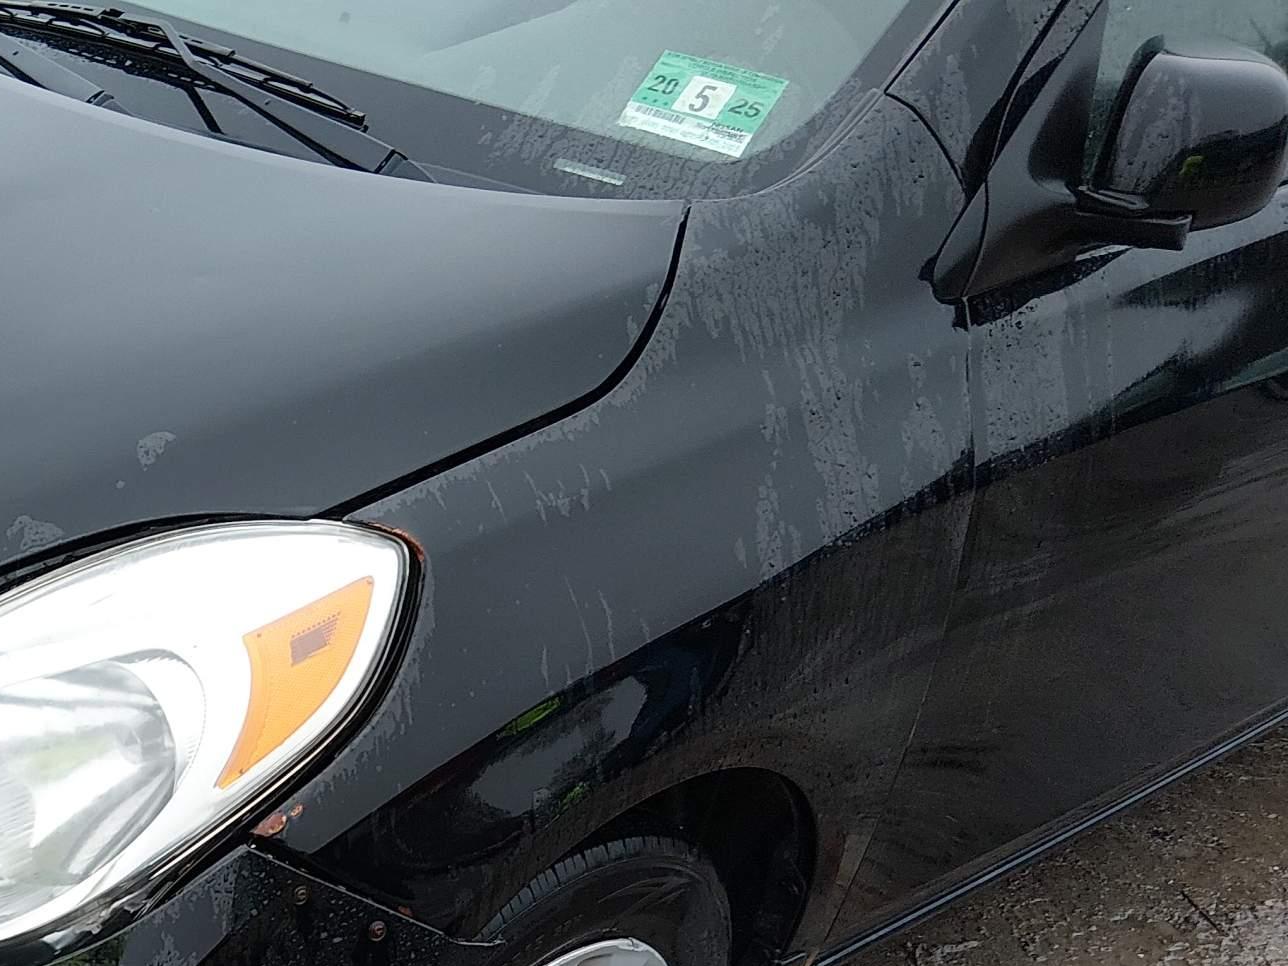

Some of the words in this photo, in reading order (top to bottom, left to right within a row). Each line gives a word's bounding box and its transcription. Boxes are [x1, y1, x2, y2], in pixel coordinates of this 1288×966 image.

[647, 74, 680, 95] 20
[688, 84, 717, 113] 5
[727, 98, 765, 118] 25
